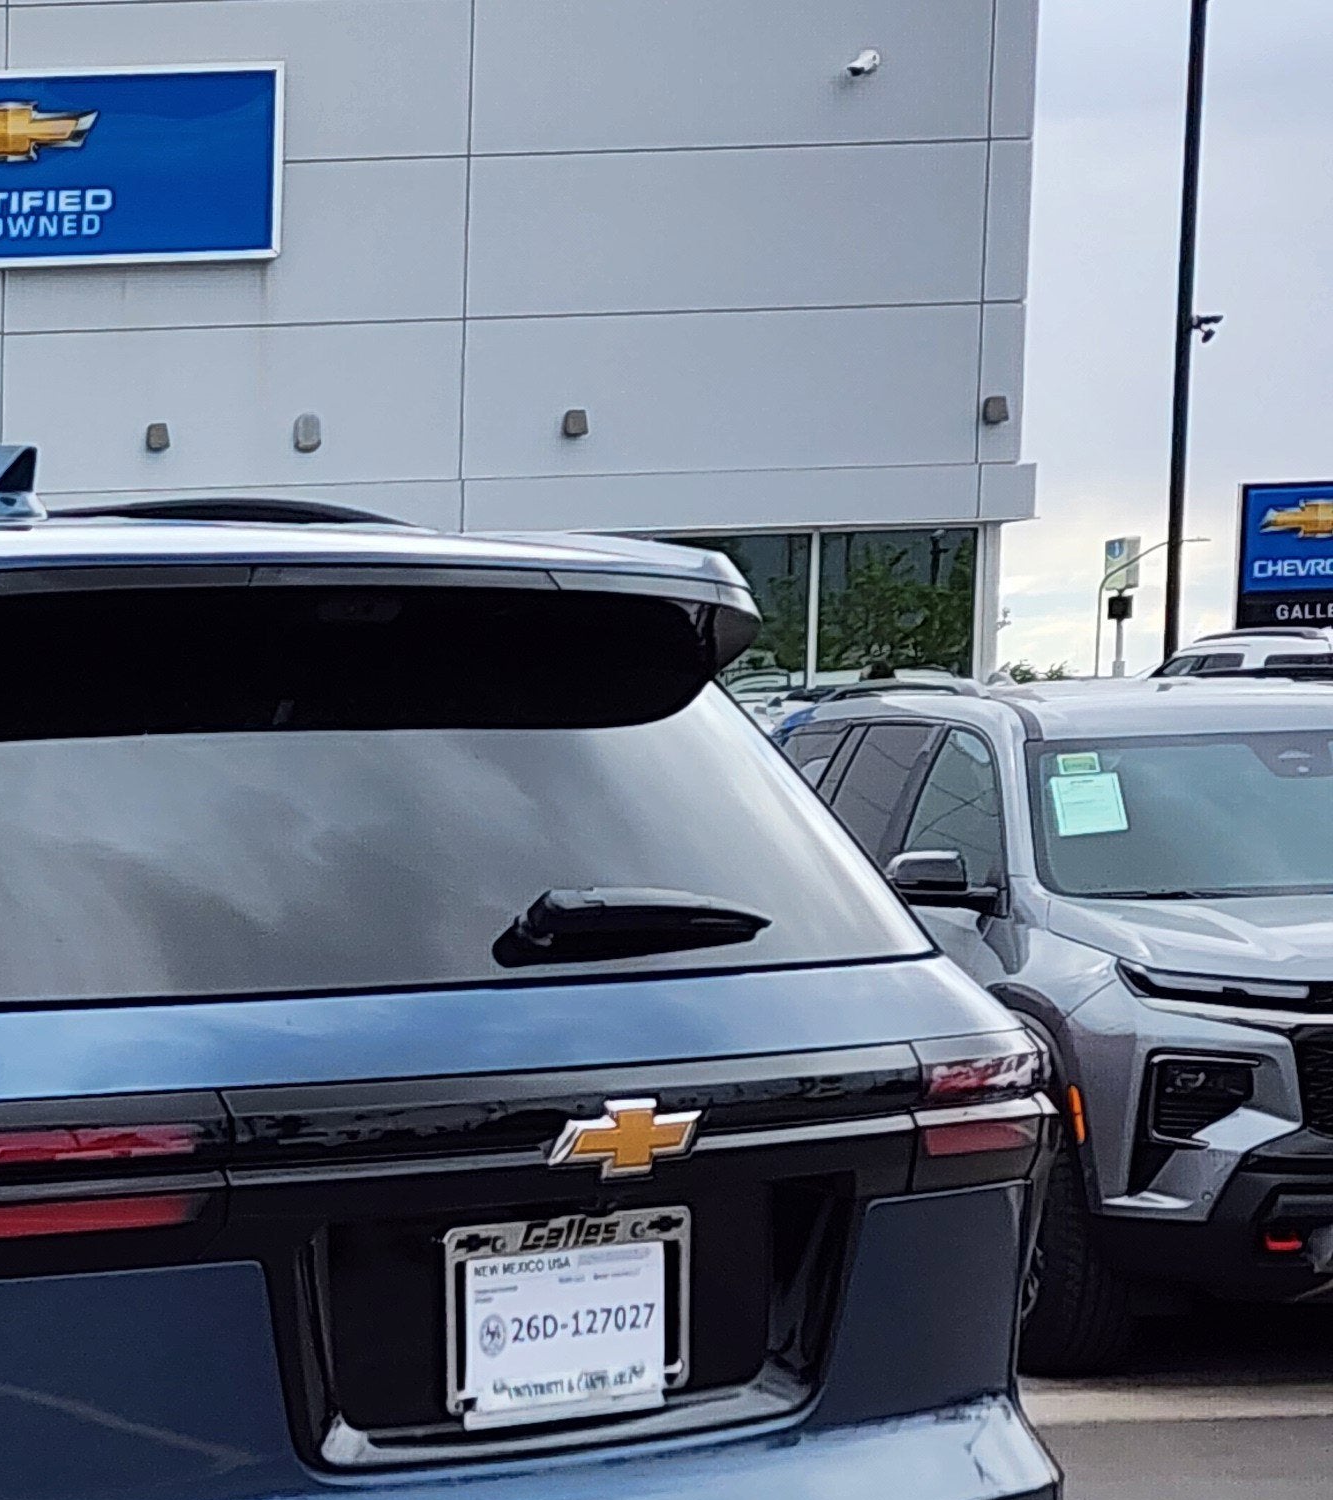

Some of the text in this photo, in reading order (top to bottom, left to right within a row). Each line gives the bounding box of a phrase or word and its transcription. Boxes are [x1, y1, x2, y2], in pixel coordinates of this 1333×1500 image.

[474, 1262, 499, 1277] NEW
[502, 1258, 544, 1275] MEXICO
[511, 1303, 655, 1342] 26D-127027
